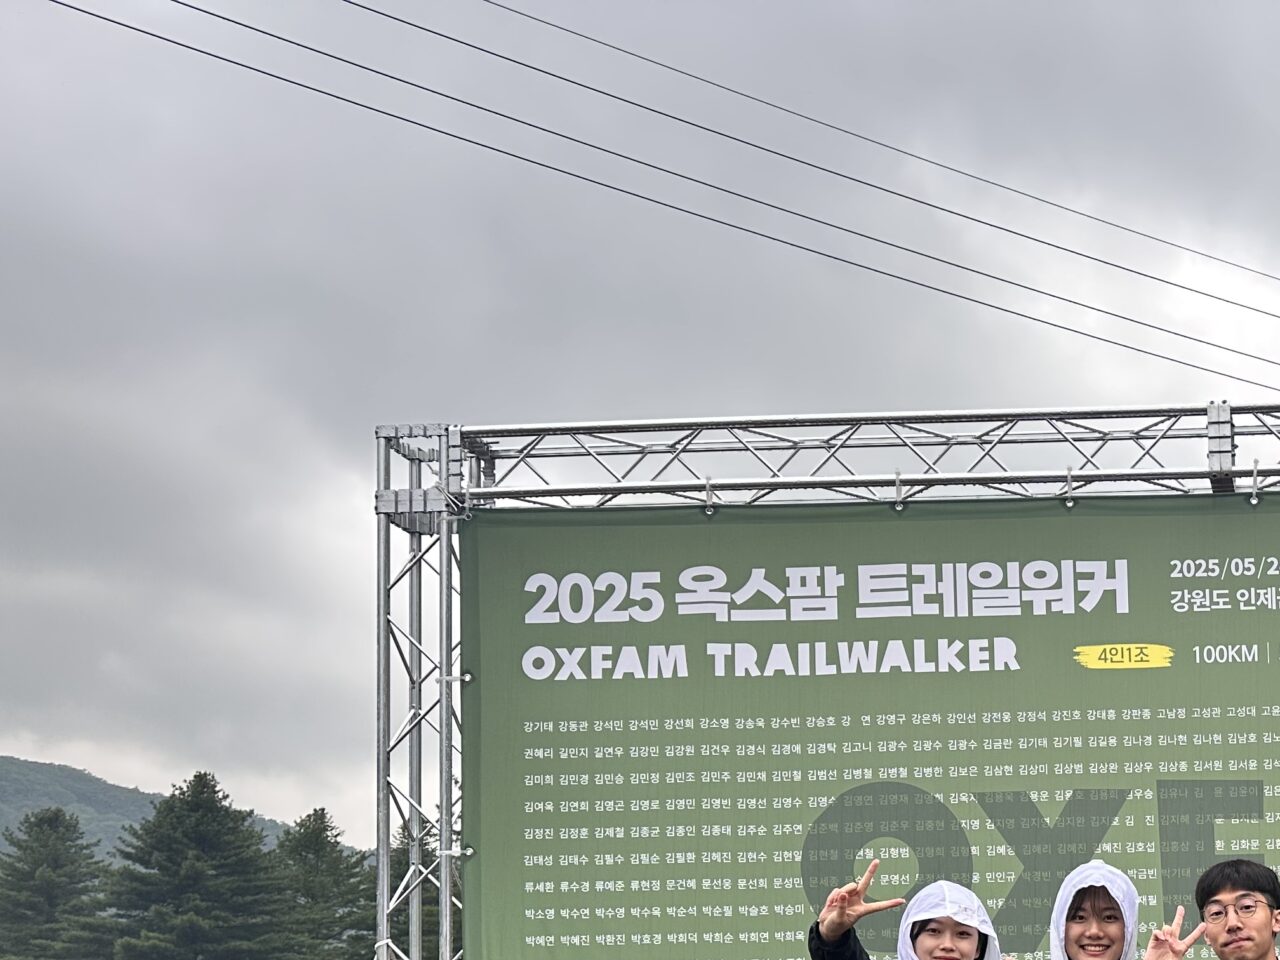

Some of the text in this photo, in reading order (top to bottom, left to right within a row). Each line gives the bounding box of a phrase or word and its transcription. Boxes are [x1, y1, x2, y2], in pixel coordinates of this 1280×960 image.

[524, 559, 1129, 624] 2025 옥스팜 트레일워커
[1169, 589, 1232, 612] 강원도
[521, 637, 1021, 681] OXFAM TRAILWALKER
[1097, 646, 1151, 664] 4인1조
[1192, 644, 1259, 664] 100KM
[524, 721, 553, 732] 강기태
[594, 720, 623, 731] 강석민
[559, 747, 588, 758] 길민지
[630, 746, 659, 757] 김강민
[560, 774, 588, 785] 김민경
[630, 773, 659, 784] 김민정
[524, 828, 553, 839] 김정진
[559, 828, 588, 839] 김정훈
[524, 855, 553, 866] 김태성
[559, 855, 589, 865] 김태수
[630, 880, 660, 891] 류현정
[525, 908, 554, 919] 박소영
[560, 908, 589, 919] 박수연
